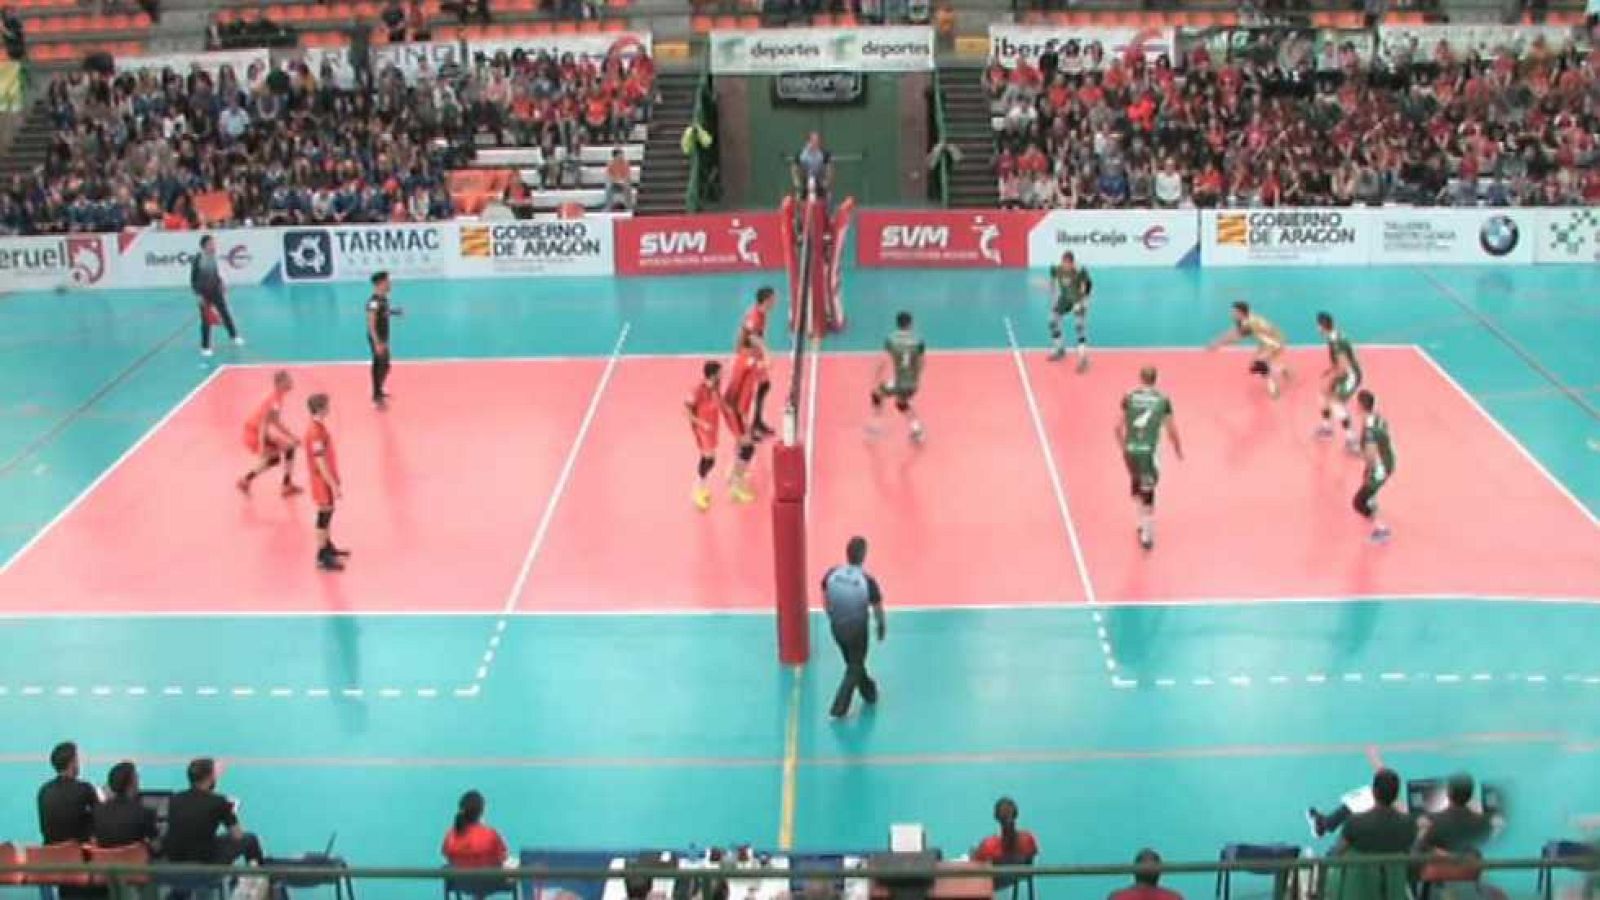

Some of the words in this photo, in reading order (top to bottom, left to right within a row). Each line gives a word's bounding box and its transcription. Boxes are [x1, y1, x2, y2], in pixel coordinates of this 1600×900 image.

[751, 42, 820, 58] deportes
[862, 41, 931, 58] deportes
[1249, 212, 1343, 228] GOBIERNO
[493, 222, 588, 240] GOBIERNO
[880, 224, 950, 248] SVM
[1249, 229, 1268, 244] DE
[336, 228, 440, 252] TARMAC
[494, 241, 515, 256] DE
[639, 231, 706, 255] SVM
[1132, 407, 1155, 429] 7
